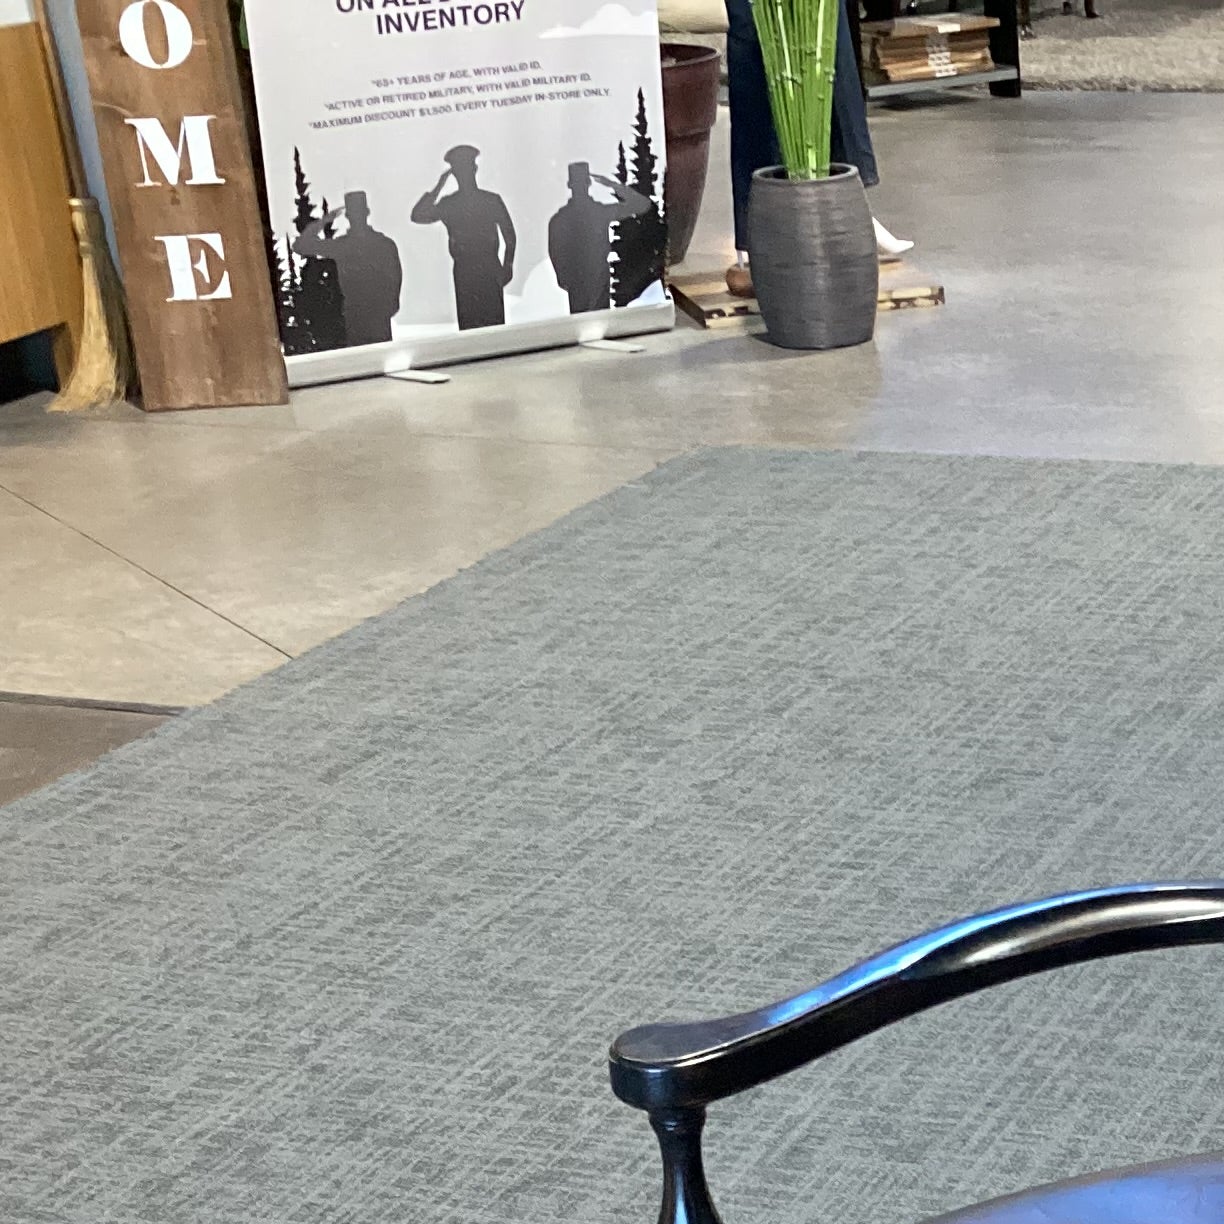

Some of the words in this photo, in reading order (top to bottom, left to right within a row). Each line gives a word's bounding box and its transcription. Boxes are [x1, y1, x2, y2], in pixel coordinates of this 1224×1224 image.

[376, 0, 524, 35] INVENTORY
[366, 96, 380, 105] OR
[382, 92, 426, 104] RETIRED
[476, 81, 502, 93] WITH
[504, 79, 531, 90] VALID
[533, 74, 578, 86] MILITARY
[397, 75, 431, 85] YEARS
[433, 71, 446, 81] OF
[473, 66, 499, 77] WITH
[502, 62, 528, 74] VALID
[365, 108, 416, 123] DISCOUNT
[455, 101, 487, 113] EVERY
[490, 95, 532, 108] TUESDAY
[535, 88, 581, 102] IN-STORE
